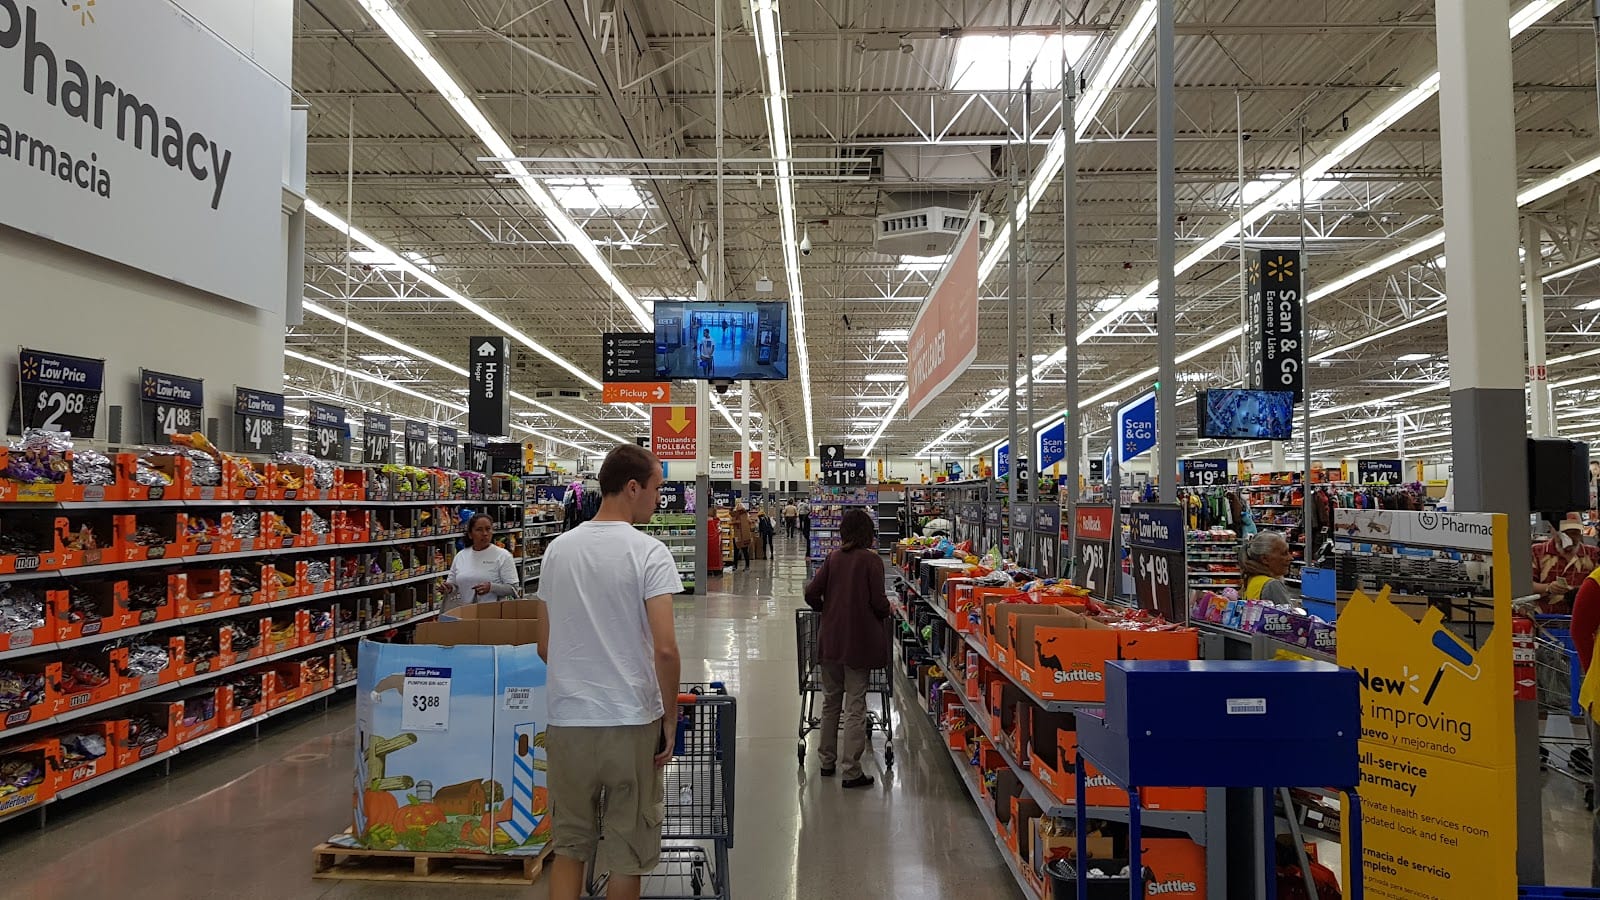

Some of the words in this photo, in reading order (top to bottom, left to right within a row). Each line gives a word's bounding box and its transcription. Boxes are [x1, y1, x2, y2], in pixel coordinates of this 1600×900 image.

[0, 122, 111, 199] armacia
[1266, 290, 1276, 328] Escanee
[1280, 289, 1297, 333] Scan
[1267, 338, 1277, 360] Listo
[1280, 338, 1298, 353] &
[40, 363, 62, 379] Low
[62, 367, 87, 382] Price
[474, 362, 483, 383] Hogar
[485, 362, 497, 399] Home
[1280, 357, 1298, 385] Go
[156, 383, 173, 396] Low
[172, 386, 192, 399] Price
[620, 389, 648, 399] Pickup
[247, 398, 261, 410] Low
[260, 400, 276, 412] Price
[1125, 418, 1152, 429] Scan
[1042, 437, 1063, 446] Scan
[1082, 516, 1101, 532] Rollback
[1139, 519, 1152, 538] Low
[1151, 520, 1169, 540] Price
[1441, 516, 1493, 536] Pharmac
[1263, 614, 1280, 624] ICE
[1263, 622, 1292, 632] CUBES
[1314, 630, 1329, 640] ICE
[1314, 639, 1337, 647] CUBE
[1053, 668, 1102, 684] Skittles
[1352, 666, 1405, 696] New
[1371, 699, 1472, 742] improving
[1361, 727, 1389, 740] uevo
[1392, 735, 1399, 745] y
[1401, 736, 1457, 755] mejorando
[1358, 751, 1428, 778] ull-service
[1359, 768, 1417, 797] harmacy
[0, 794, 35, 811] utterfinger
[1390, 804, 1418, 820] health
[1420, 813, 1460, 831] services
[1462, 824, 1489, 838] room
[1397, 822, 1417, 836] look
[1419, 831, 1437, 841] and
[1439, 834, 1458, 847] feel
[1363, 847, 1394, 863] rmacia
[1396, 856, 1409, 867] de
[1411, 862, 1451, 880] servicio
[1363, 860, 1397, 876] mpleto
[1147, 879, 1197, 896] Skittles
